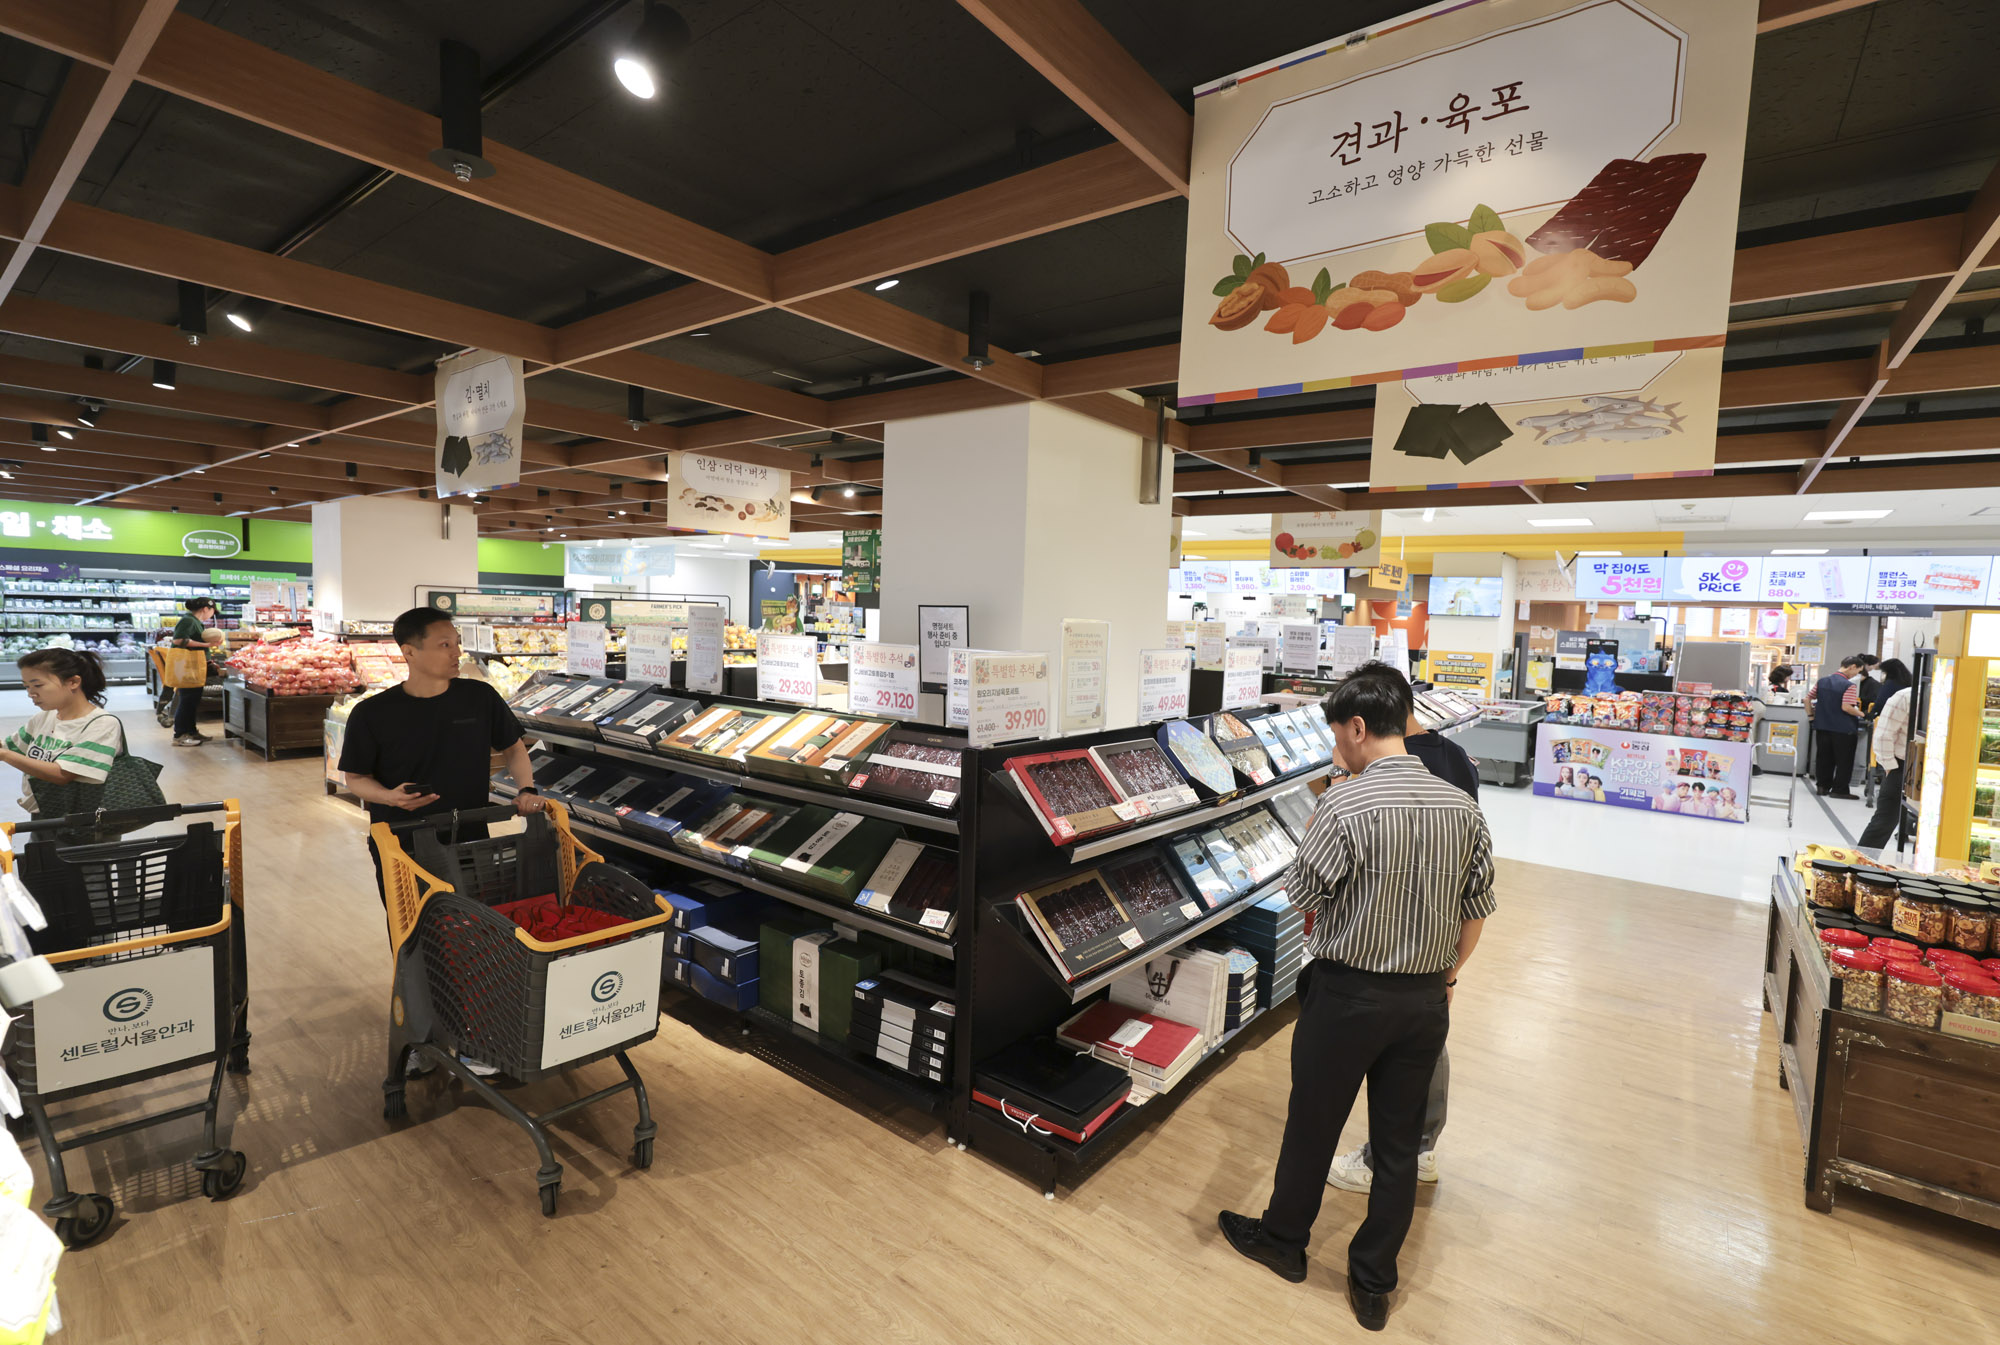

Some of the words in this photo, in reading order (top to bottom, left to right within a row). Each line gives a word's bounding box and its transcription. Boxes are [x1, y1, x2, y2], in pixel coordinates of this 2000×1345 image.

[1308, 175, 1379, 205] 고소하고
[1388, 160, 1426, 186] 영양
[1433, 141, 1495, 173] 가득한
[1504, 130, 1548, 157] 선물
[465, 380, 490, 404] 김·멸치
[696, 458, 767, 480] 인삼·더덕·버섯
[1593, 563, 1609, 575] 막
[1611, 563, 1651, 575] 집어도
[1698, 572, 1721, 582] 5K
[1769, 571, 1806, 579] 초극세모
[1600, 575, 1662, 595] 5천원
[1877, 579, 1896, 588] 크랩
[1900, 579, 1918, 588] 3팩
[580, 657, 603, 671] 44,940
[641, 663, 667, 679] 34,230
[991, 663, 1017, 679] 특별한
[1019, 663, 1035, 677] 추석
[778, 678, 813, 695] 29,330
[1238, 686, 1259, 701] 29,960
[876, 689, 915, 710] 29,120
[1157, 694, 1186, 711] 49,840
[1004, 707, 1046, 731] 39,910
[1610, 757, 1661, 770] KPOP
[1610, 767, 1660, 780] DEMON
[1610, 774, 1660, 787] HUNTERS
[131, 1019, 150, 1030] 보다
[559, 999, 646, 1040] 센트럴서울안과
[1948, 1021, 1973, 1031] MIXED
[1974, 1026, 1999, 1038] NUTS
[60, 1018, 195, 1063] 센트럴서울안과
